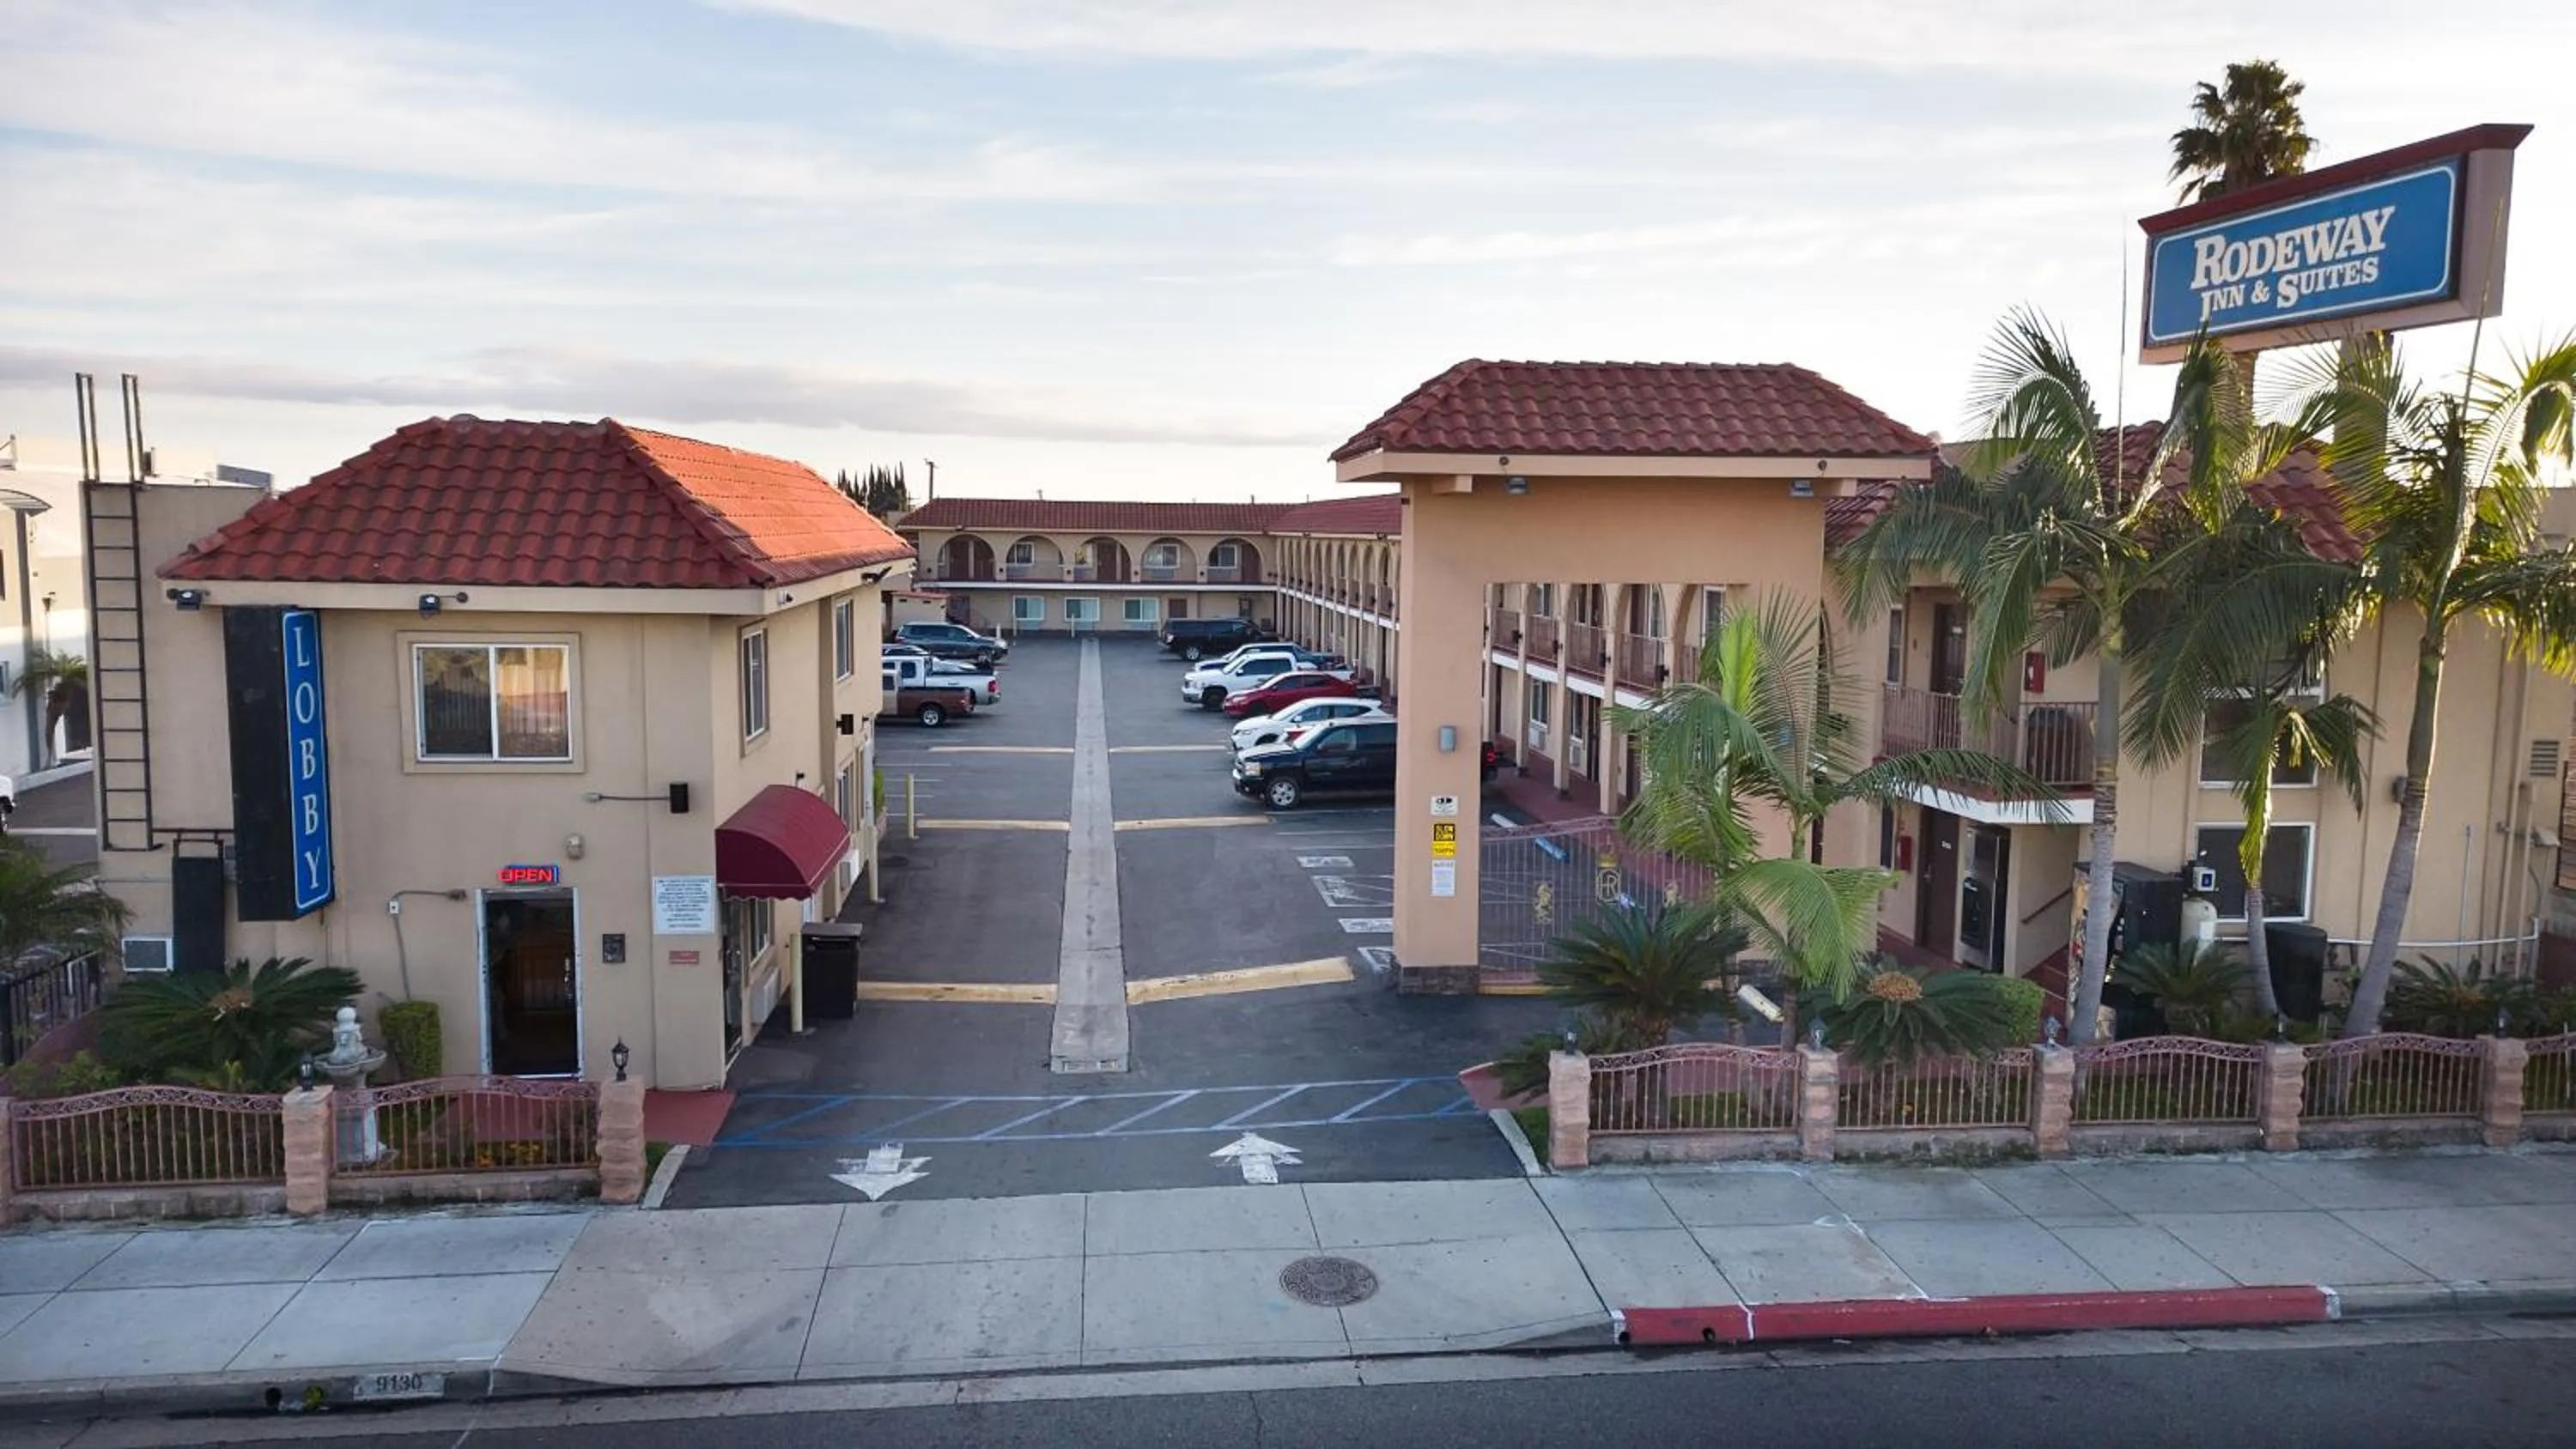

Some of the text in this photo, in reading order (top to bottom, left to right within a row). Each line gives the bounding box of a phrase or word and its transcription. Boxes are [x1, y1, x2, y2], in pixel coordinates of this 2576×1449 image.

[2190, 205, 2396, 289] RODEWAY
[2251, 280, 2270, 304] &
[2276, 256, 2380, 309] SUITES
[293, 626, 320, 889] LOBBY
[497, 867, 553, 882] OPEN
[376, 1373, 422, 1391] 9130
